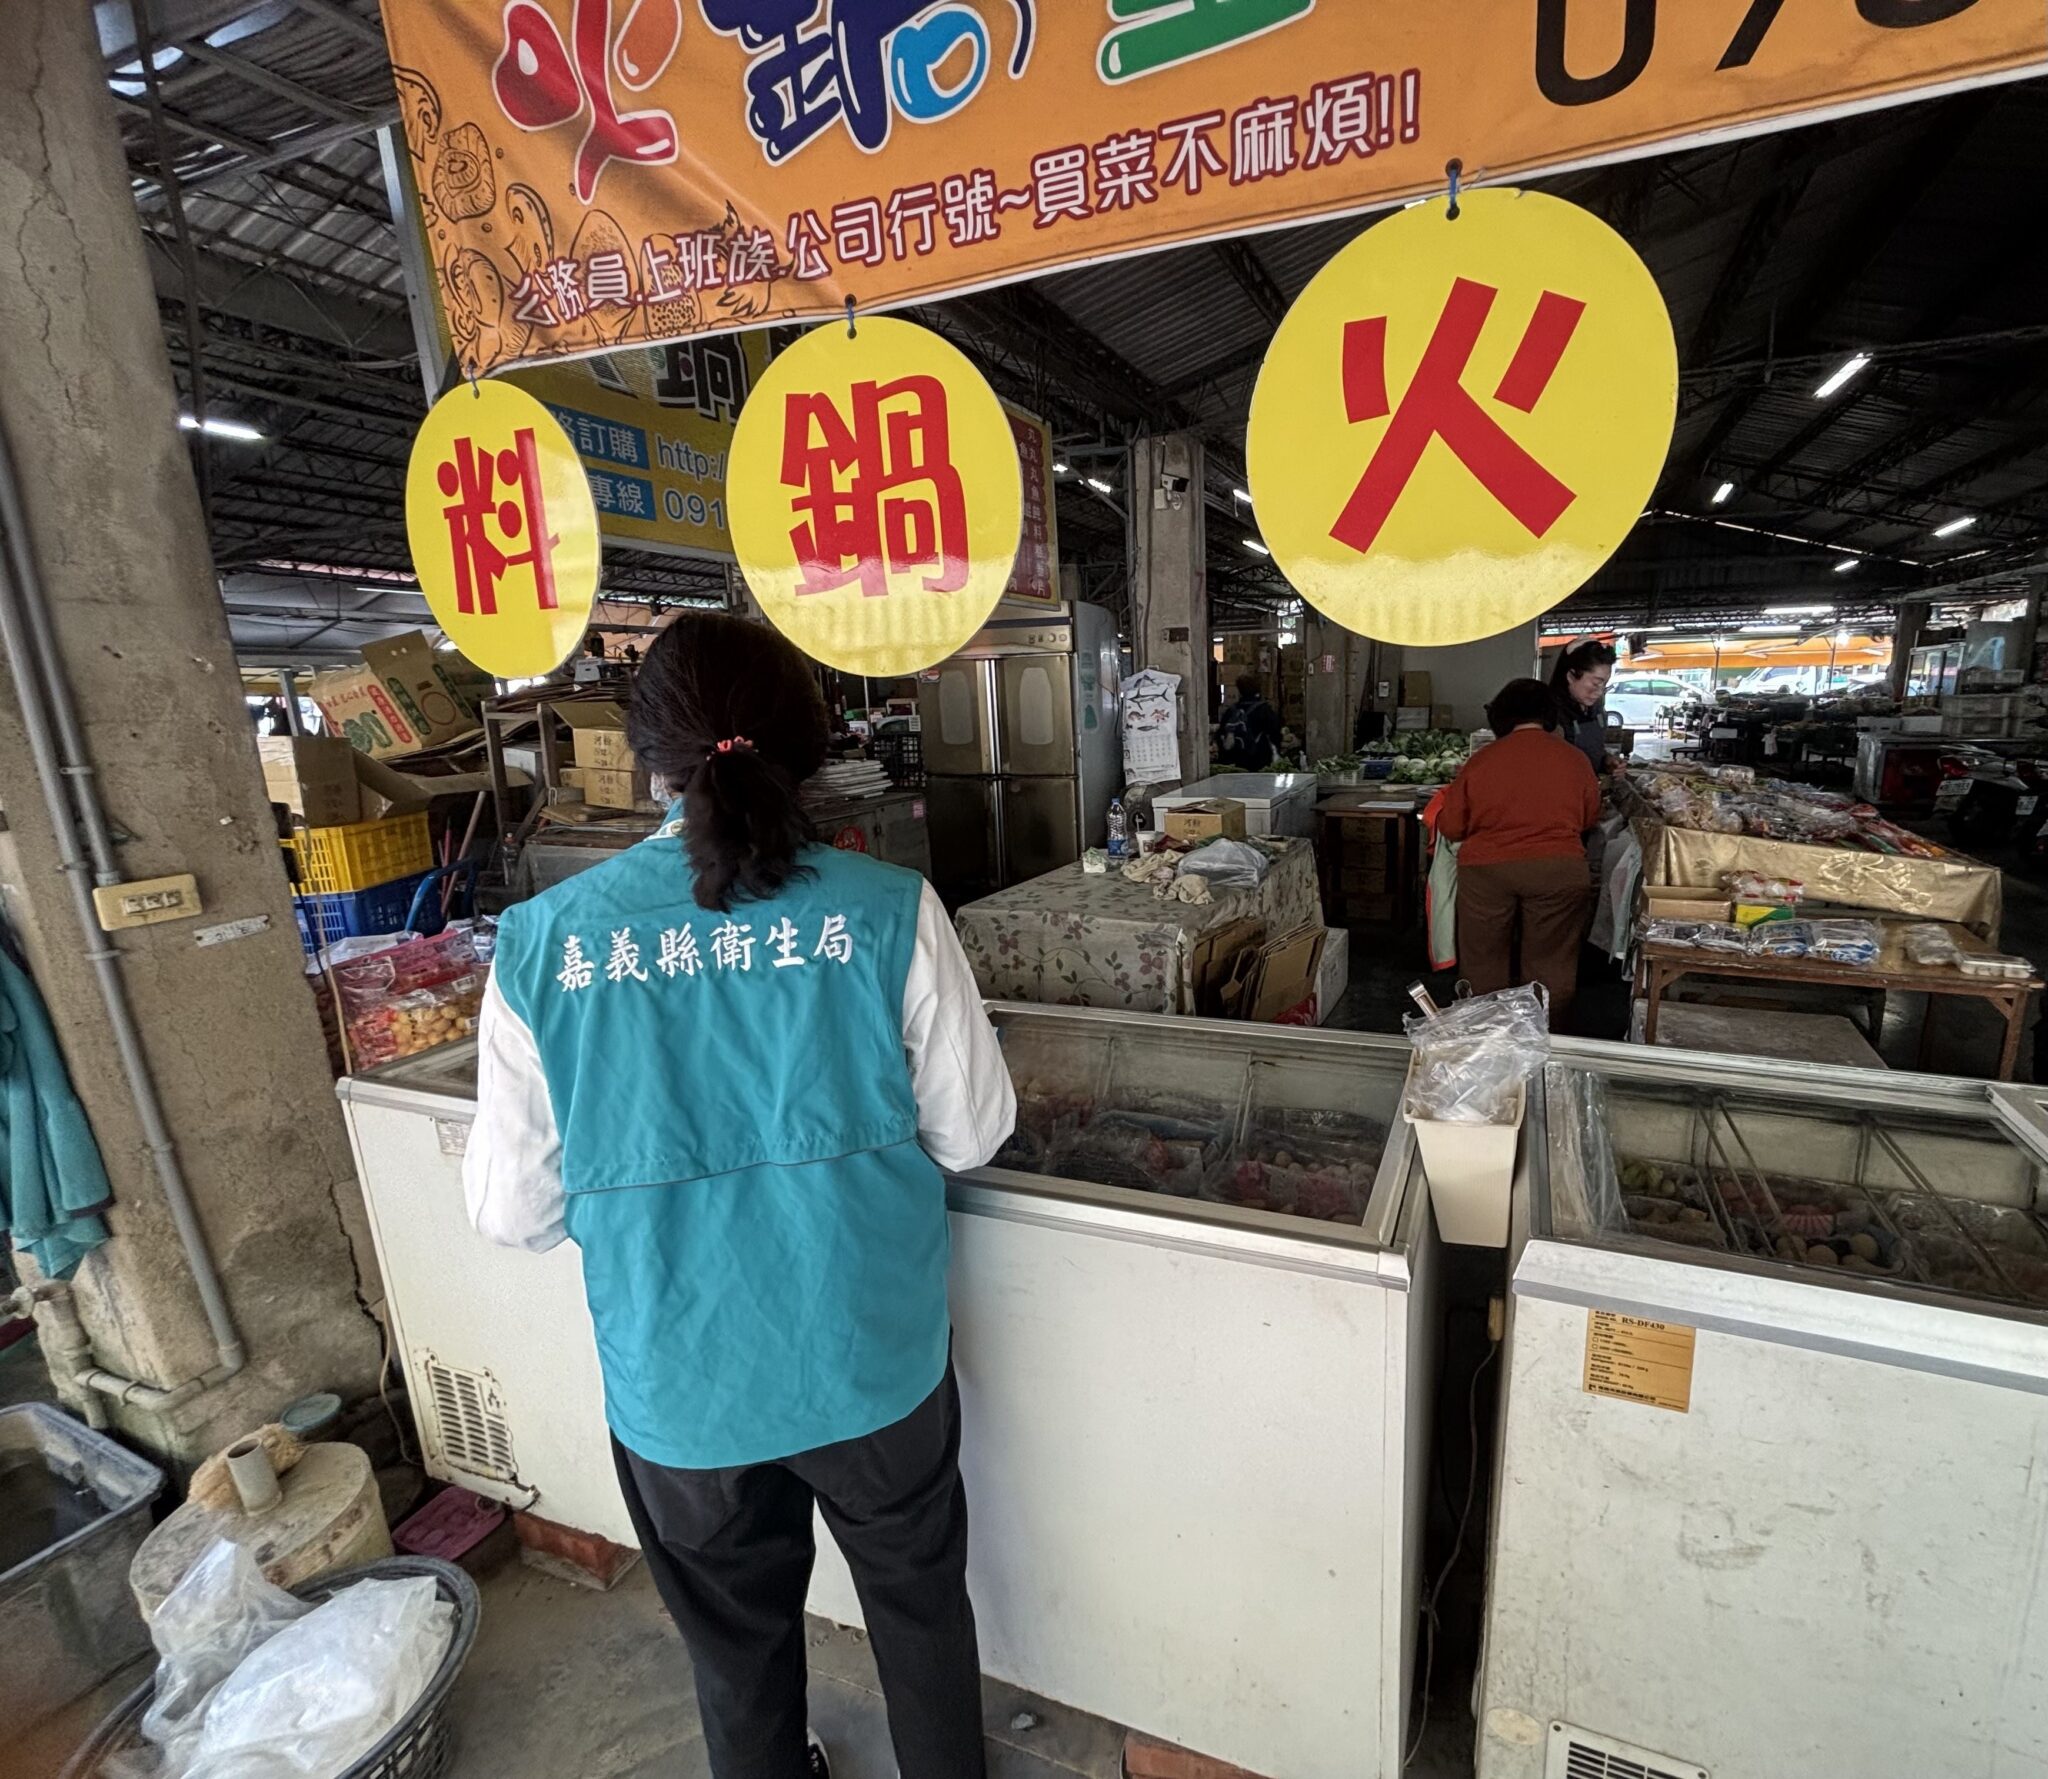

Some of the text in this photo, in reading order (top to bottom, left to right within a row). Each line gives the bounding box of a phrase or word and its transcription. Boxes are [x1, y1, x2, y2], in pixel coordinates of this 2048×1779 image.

[780, 375, 970, 597] 鍋
[1329, 276, 1587, 554] 火
[437, 428, 560, 615] 料
[556, 913, 854, 992] 嘉義縣衛生局
[1621, 1316, 1665, 1330] RS-DF430
